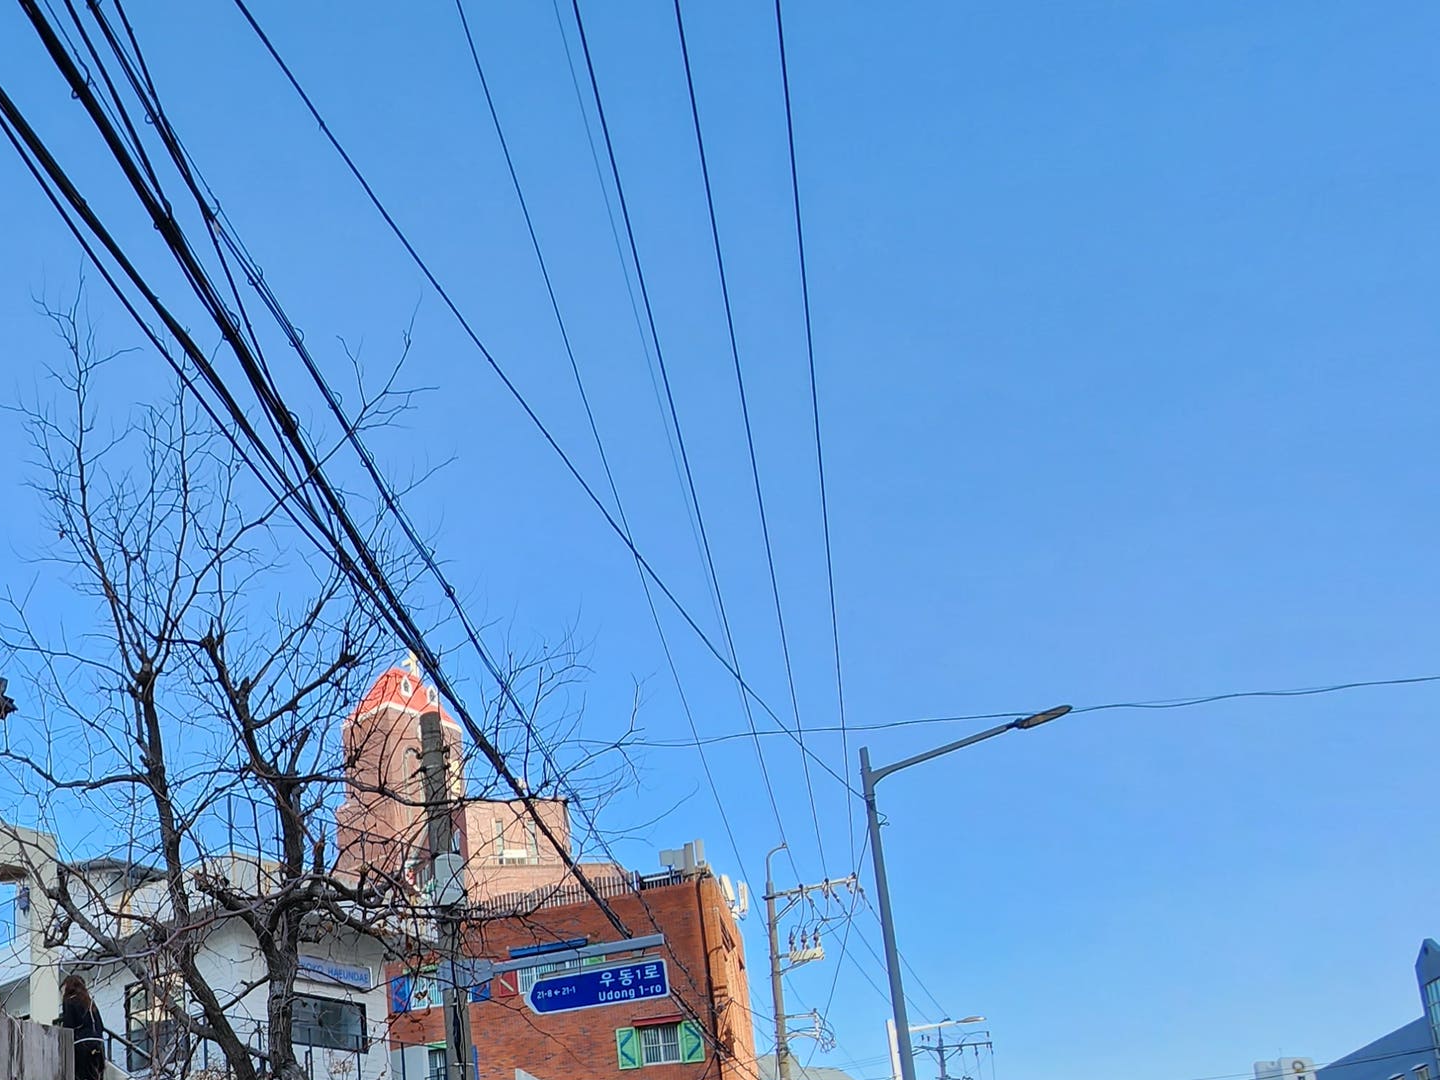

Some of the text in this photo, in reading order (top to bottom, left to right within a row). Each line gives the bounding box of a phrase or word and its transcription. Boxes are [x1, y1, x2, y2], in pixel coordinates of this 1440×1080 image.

[600, 964, 661, 988] 우동1로
[561, 985, 576, 996] 21-1
[598, 984, 662, 1002] Udong 1-ro
